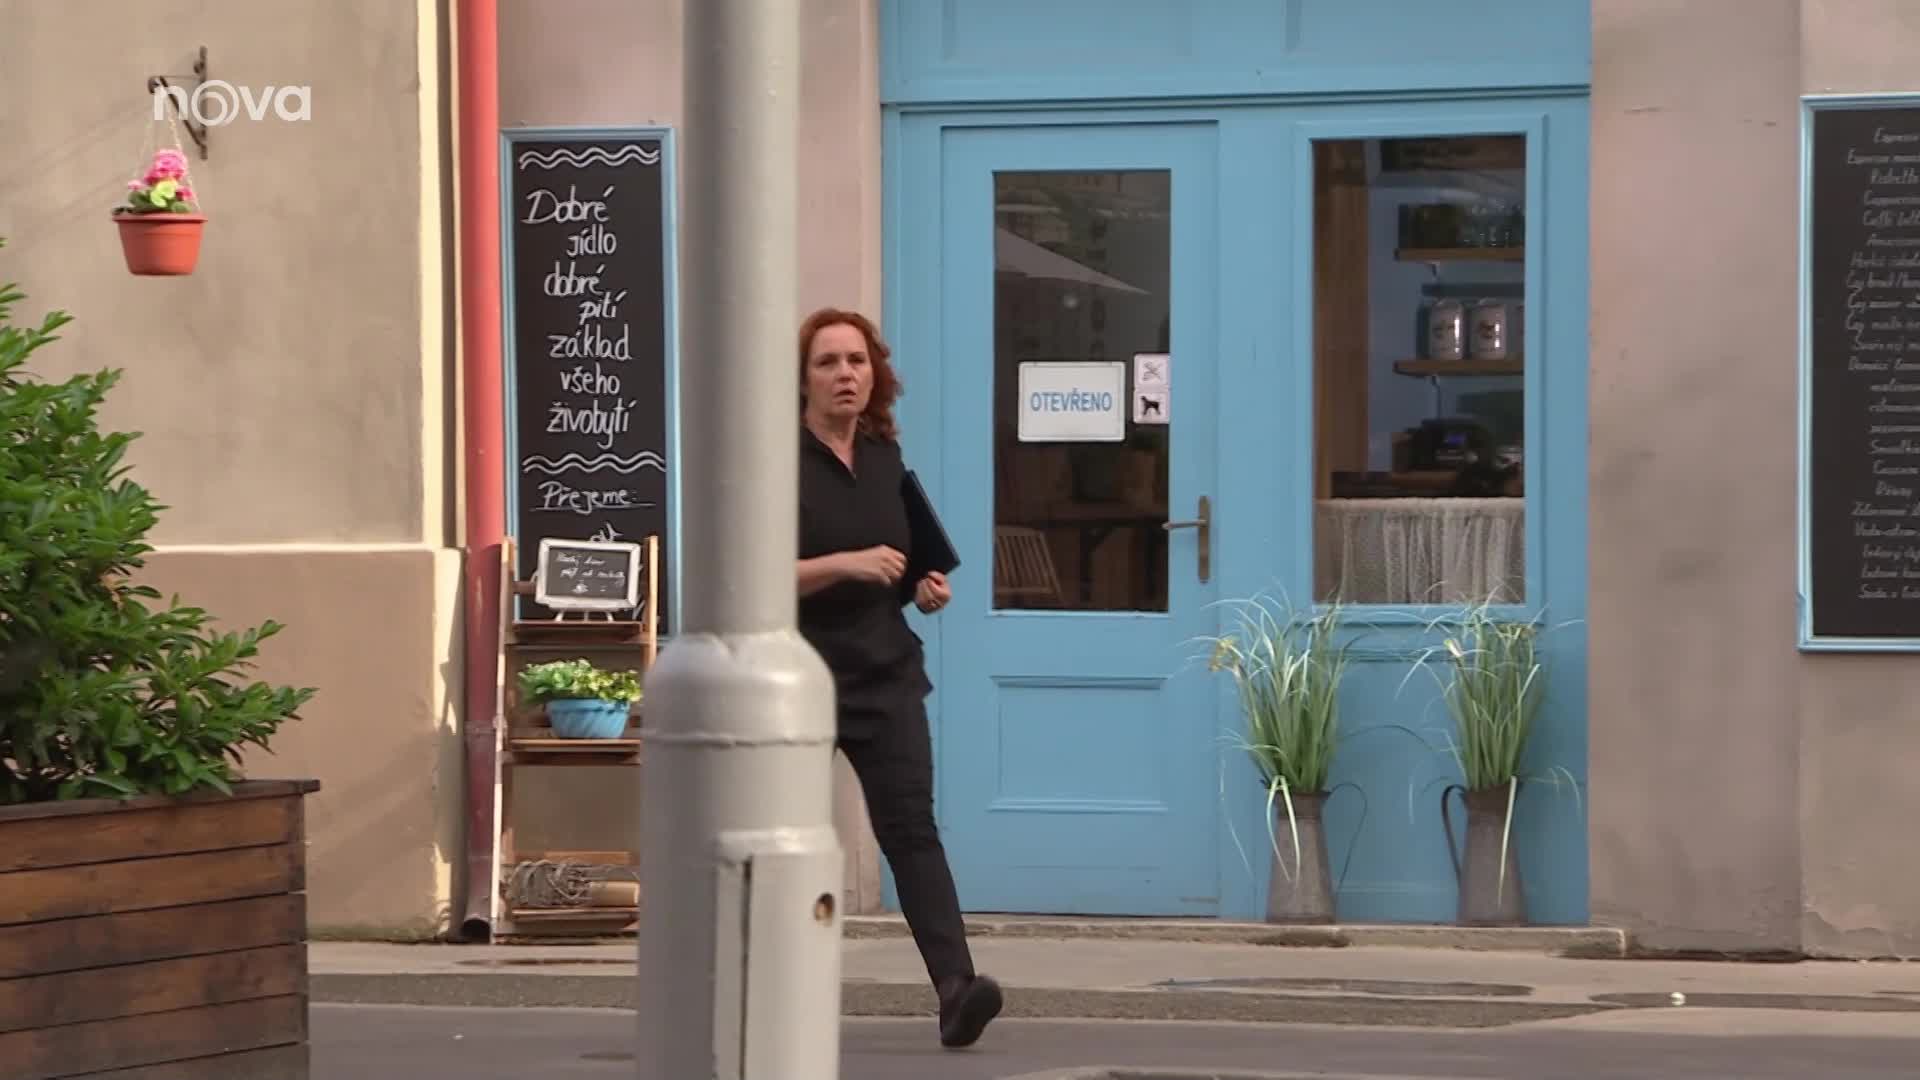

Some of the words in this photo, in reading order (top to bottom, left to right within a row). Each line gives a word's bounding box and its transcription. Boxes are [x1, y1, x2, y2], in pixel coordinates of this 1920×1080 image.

[520, 183, 616, 225] Dobré
[566, 223, 618, 258] jídlo
[543, 260, 606, 298] dobré
[578, 290, 629, 326] pití
[546, 323, 634, 362] základ
[559, 361, 621, 395] všeho
[1030, 387, 1114, 413] OTEVŘENO
[545, 397, 638, 450] živobytí
